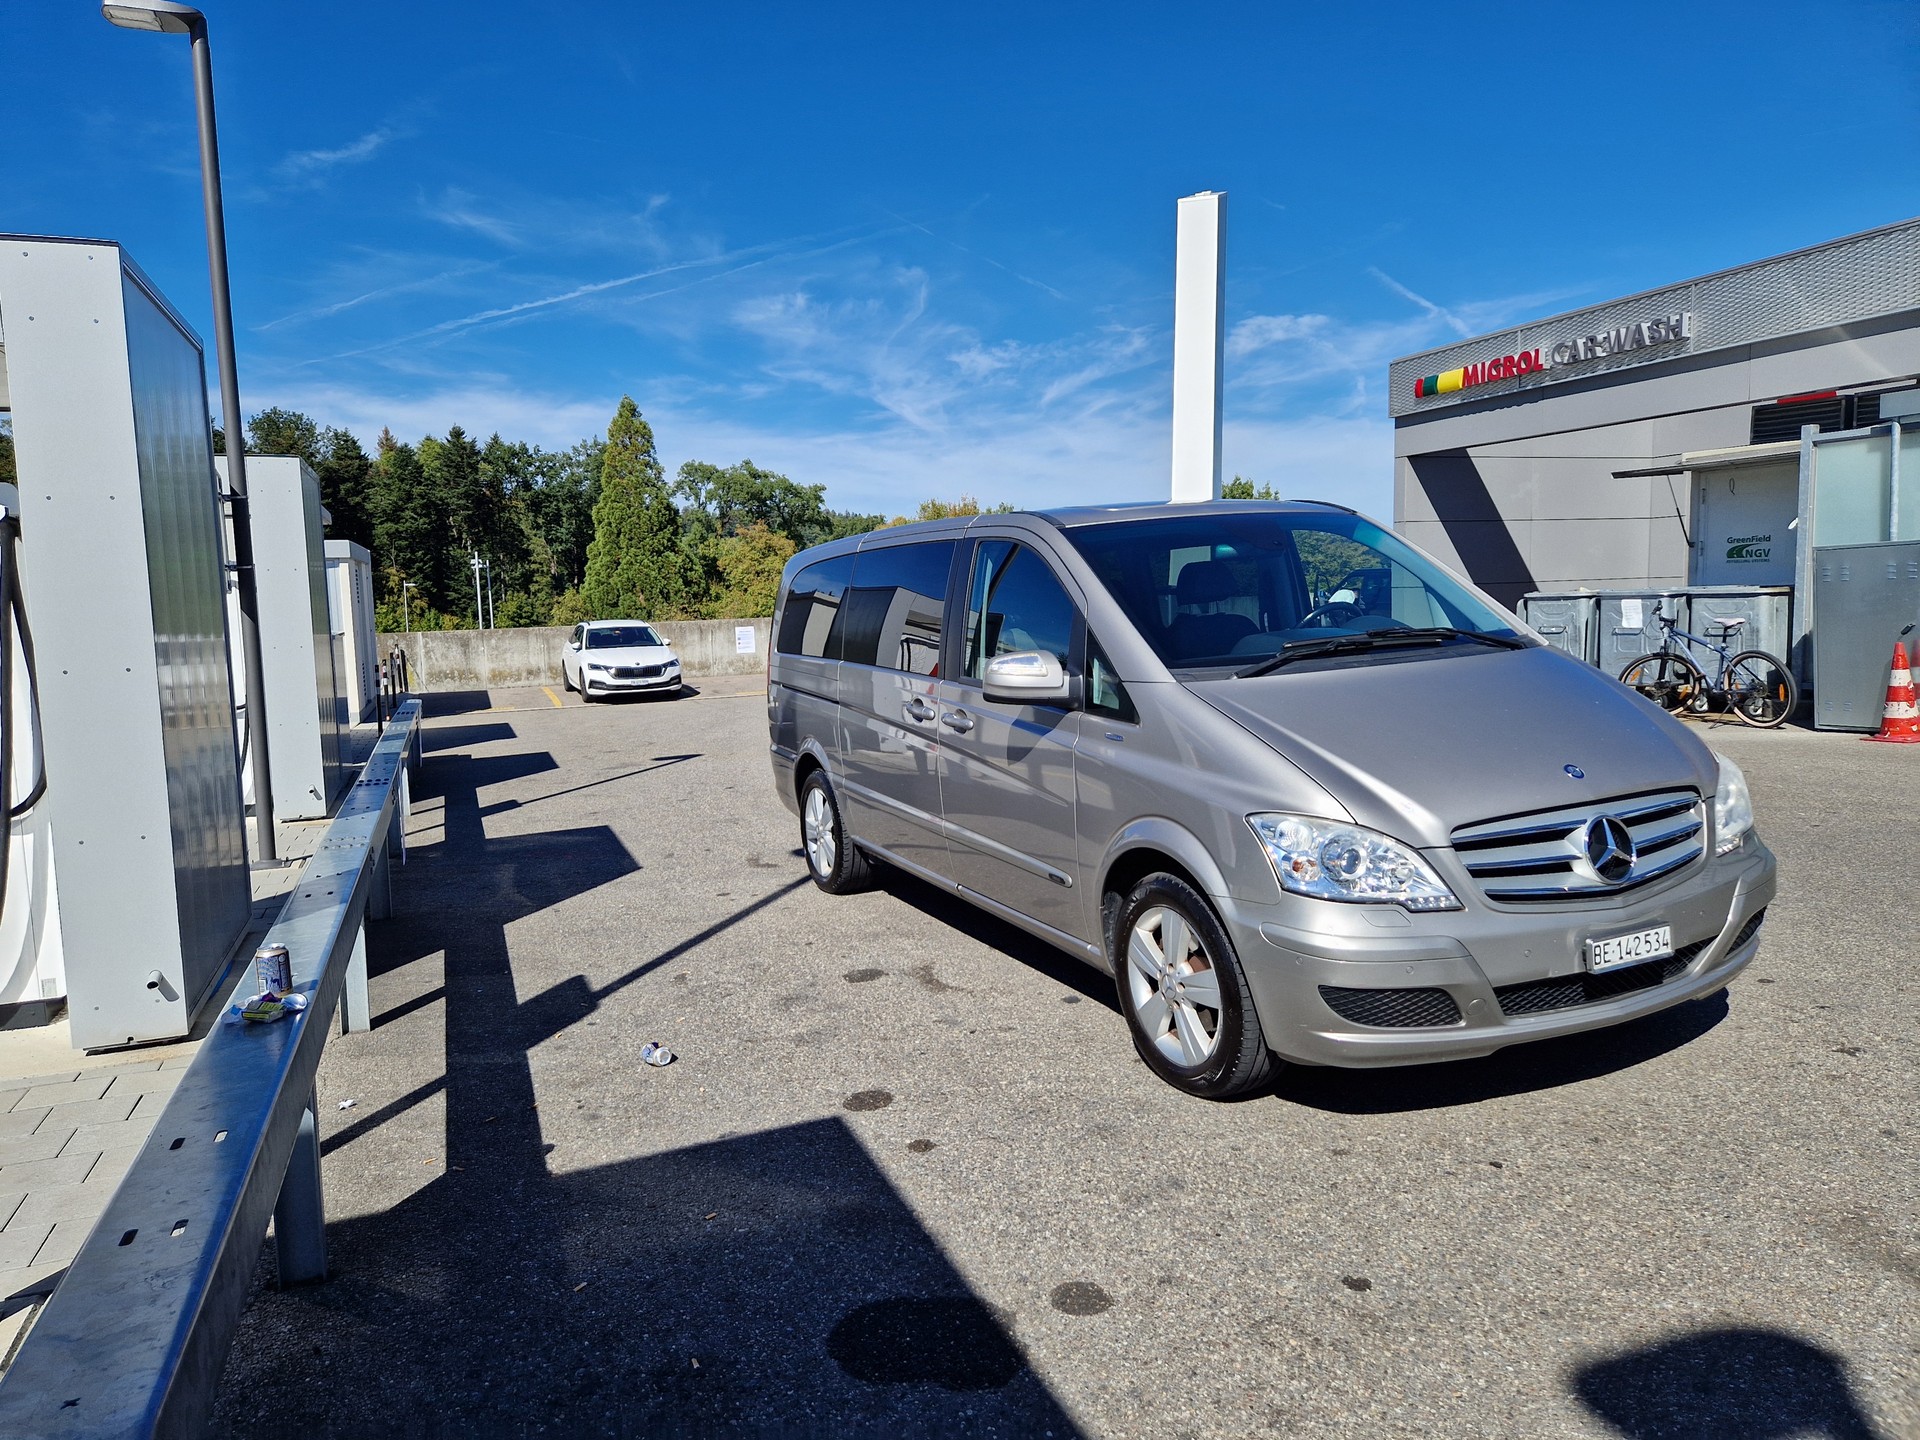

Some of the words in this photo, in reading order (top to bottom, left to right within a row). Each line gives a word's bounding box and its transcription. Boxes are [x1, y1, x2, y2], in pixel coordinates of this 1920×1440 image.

[1462, 348, 1544, 388] MIGROL
[1551, 334, 1599, 366] CAR
[1605, 312, 1685, 354] WASH
[1726, 534, 1771, 544] GreenField
[1745, 548, 1771, 558] NGV
